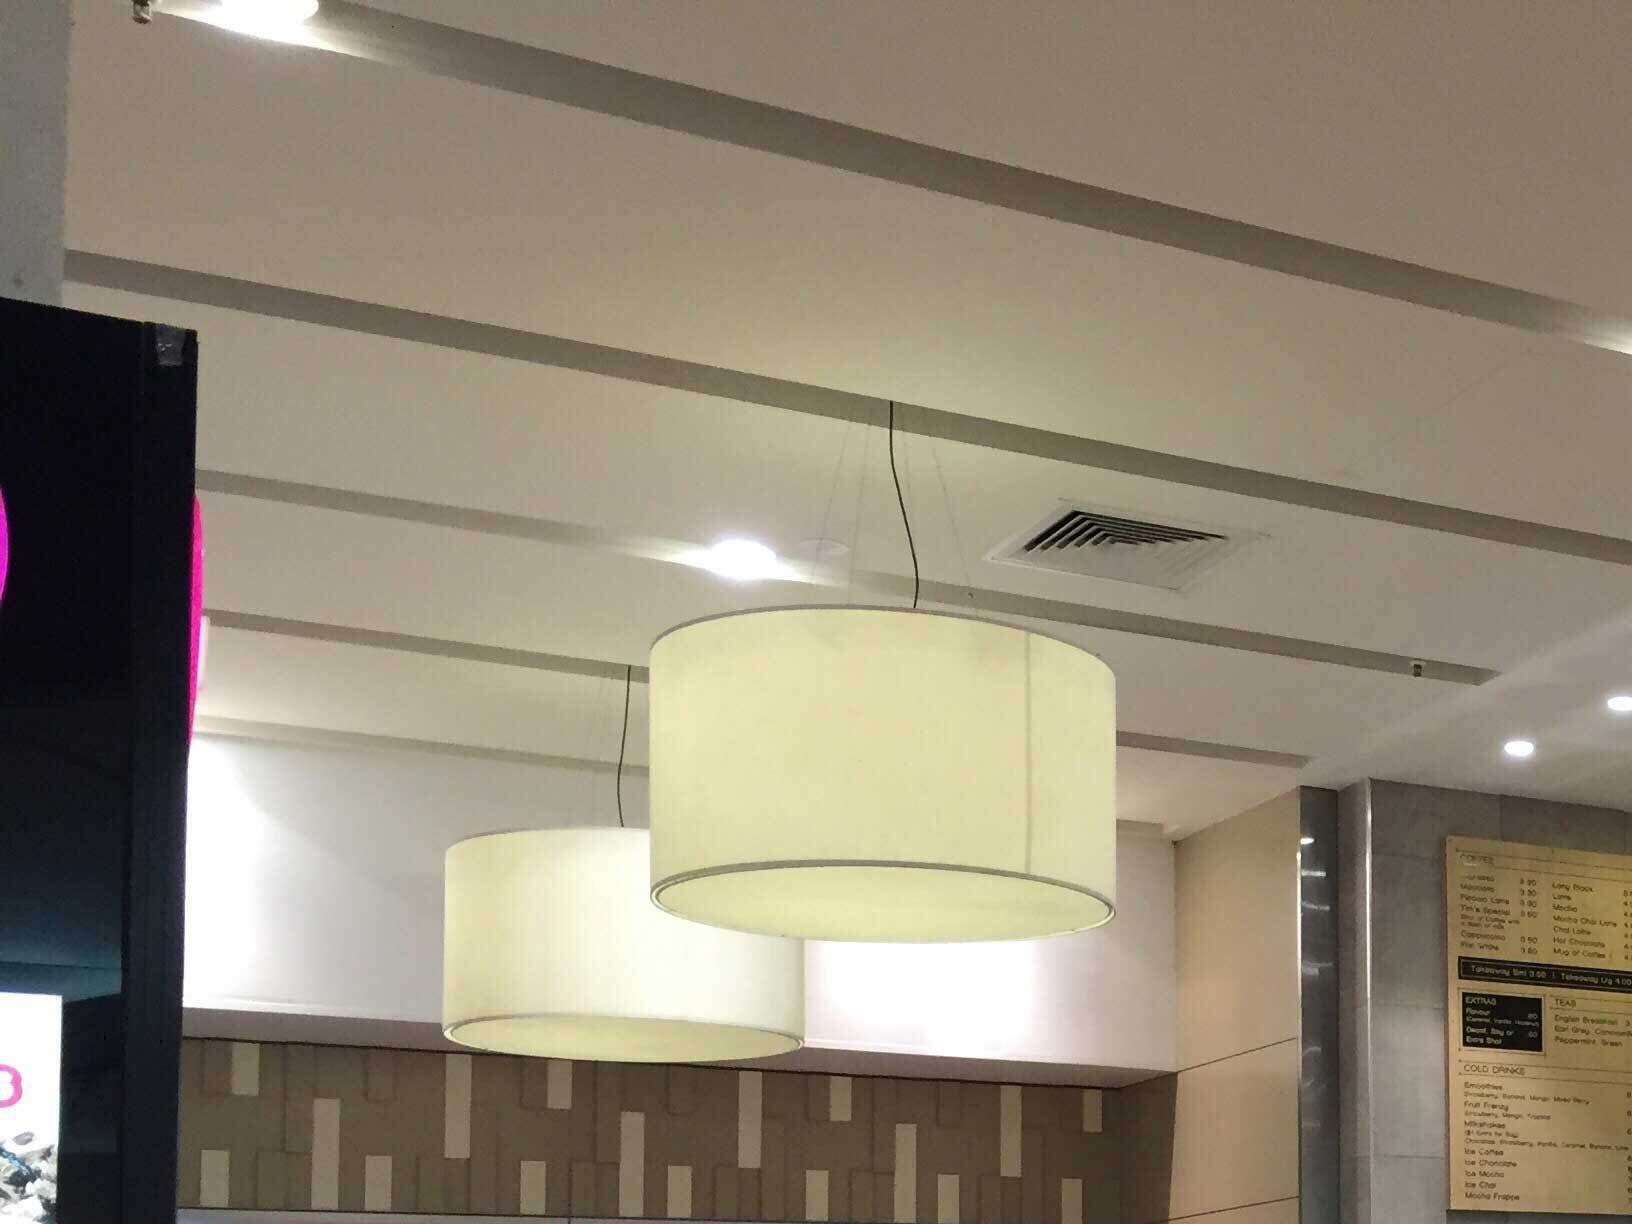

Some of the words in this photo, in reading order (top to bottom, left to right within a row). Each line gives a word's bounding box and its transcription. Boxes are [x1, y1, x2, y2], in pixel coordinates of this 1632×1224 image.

[1472, 965, 1510, 977] Takeaway
[1562, 973, 1598, 984] Takeaway
[1555, 999, 1576, 1008] TEAS
[1464, 1064, 1489, 1074] COLD
[1493, 1066, 1525, 1076] DRINKS
